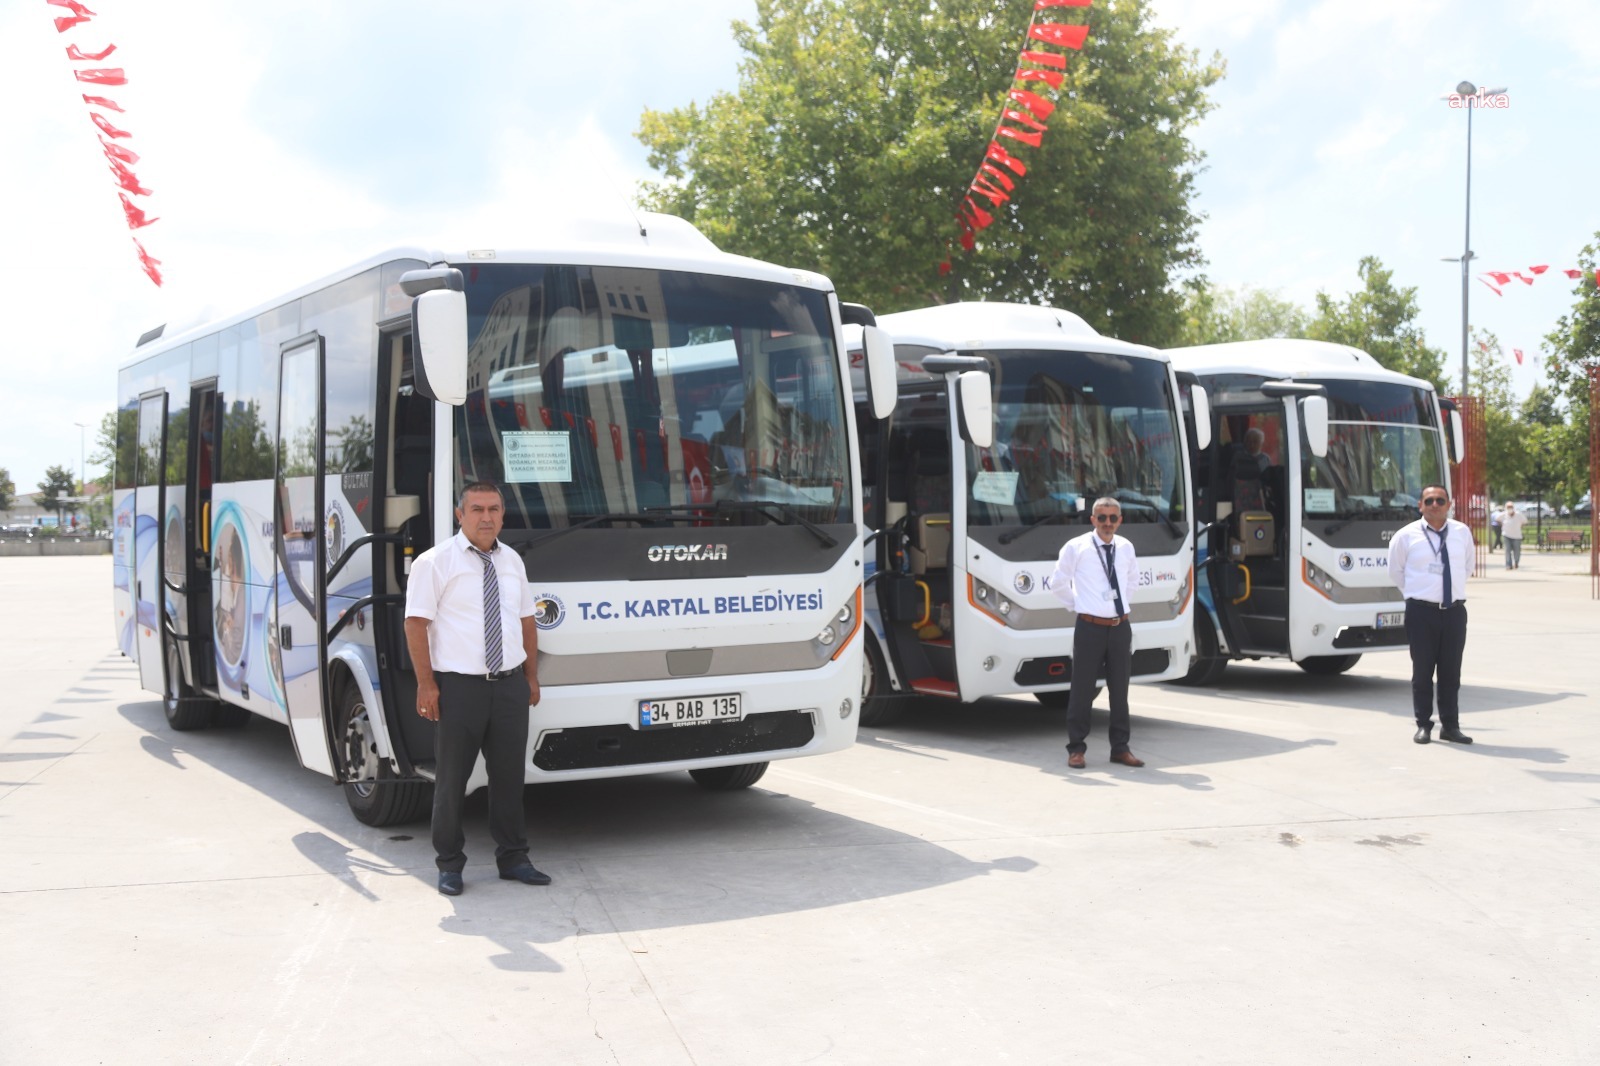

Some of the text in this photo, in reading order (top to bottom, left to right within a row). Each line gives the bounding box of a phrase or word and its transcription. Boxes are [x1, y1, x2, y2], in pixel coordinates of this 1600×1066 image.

[648, 543, 728, 562] OTOKAR
[578, 588, 823, 620] T.C. KARTAL BELEDİYESİ
[651, 697, 737, 721] 34 BAB 135
